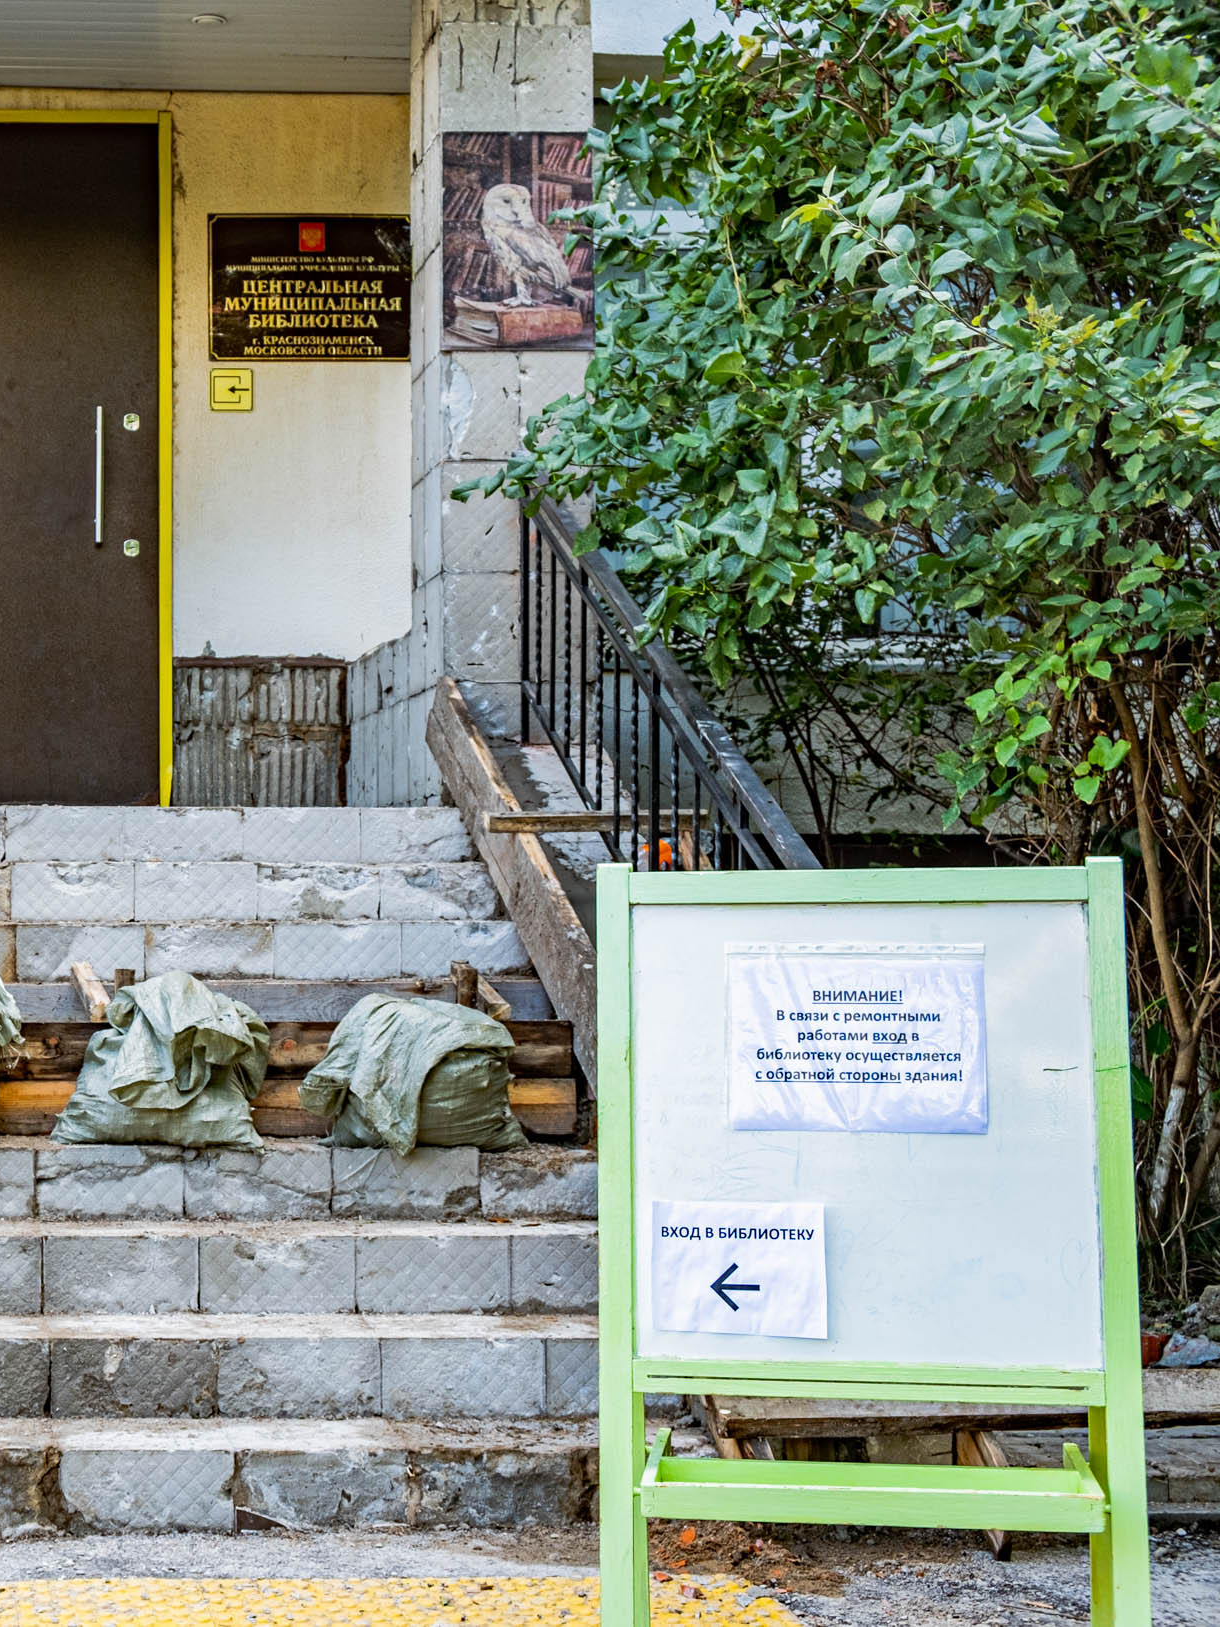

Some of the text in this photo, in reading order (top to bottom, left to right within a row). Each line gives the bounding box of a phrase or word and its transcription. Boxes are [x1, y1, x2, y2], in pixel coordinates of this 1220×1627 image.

[225, 264, 400, 272] МУНИЦИПАЛЬНОЕ УЧРЕЖДЕНИЕ КУЛЬТУРЫ
[242, 280, 383, 295] ЦЕНТРАЛЬНАЯ
[224, 296, 402, 313] МУНИЦИПАЛЬНАЯ
[249, 313, 379, 329] БИБЛИОТЕКА
[252, 336, 375, 346] г. КРАСНОЗНАМЕНСК
[244, 346, 383, 356] МОСКОВСКОЙ ОБЛАСТИ
[812, 990, 904, 1004] ВНИМАНИЕ!
[776, 1010, 941, 1024] В связи с ремонтными
[797, 1029, 919, 1044] работами вход в
[756, 1048, 962, 1063] библиотеку осуществляется
[756, 1068, 963, 1083] с обратной стороны здания!
[661, 1226, 815, 1241] ВХОД В БИБЛИОТЕКУ
